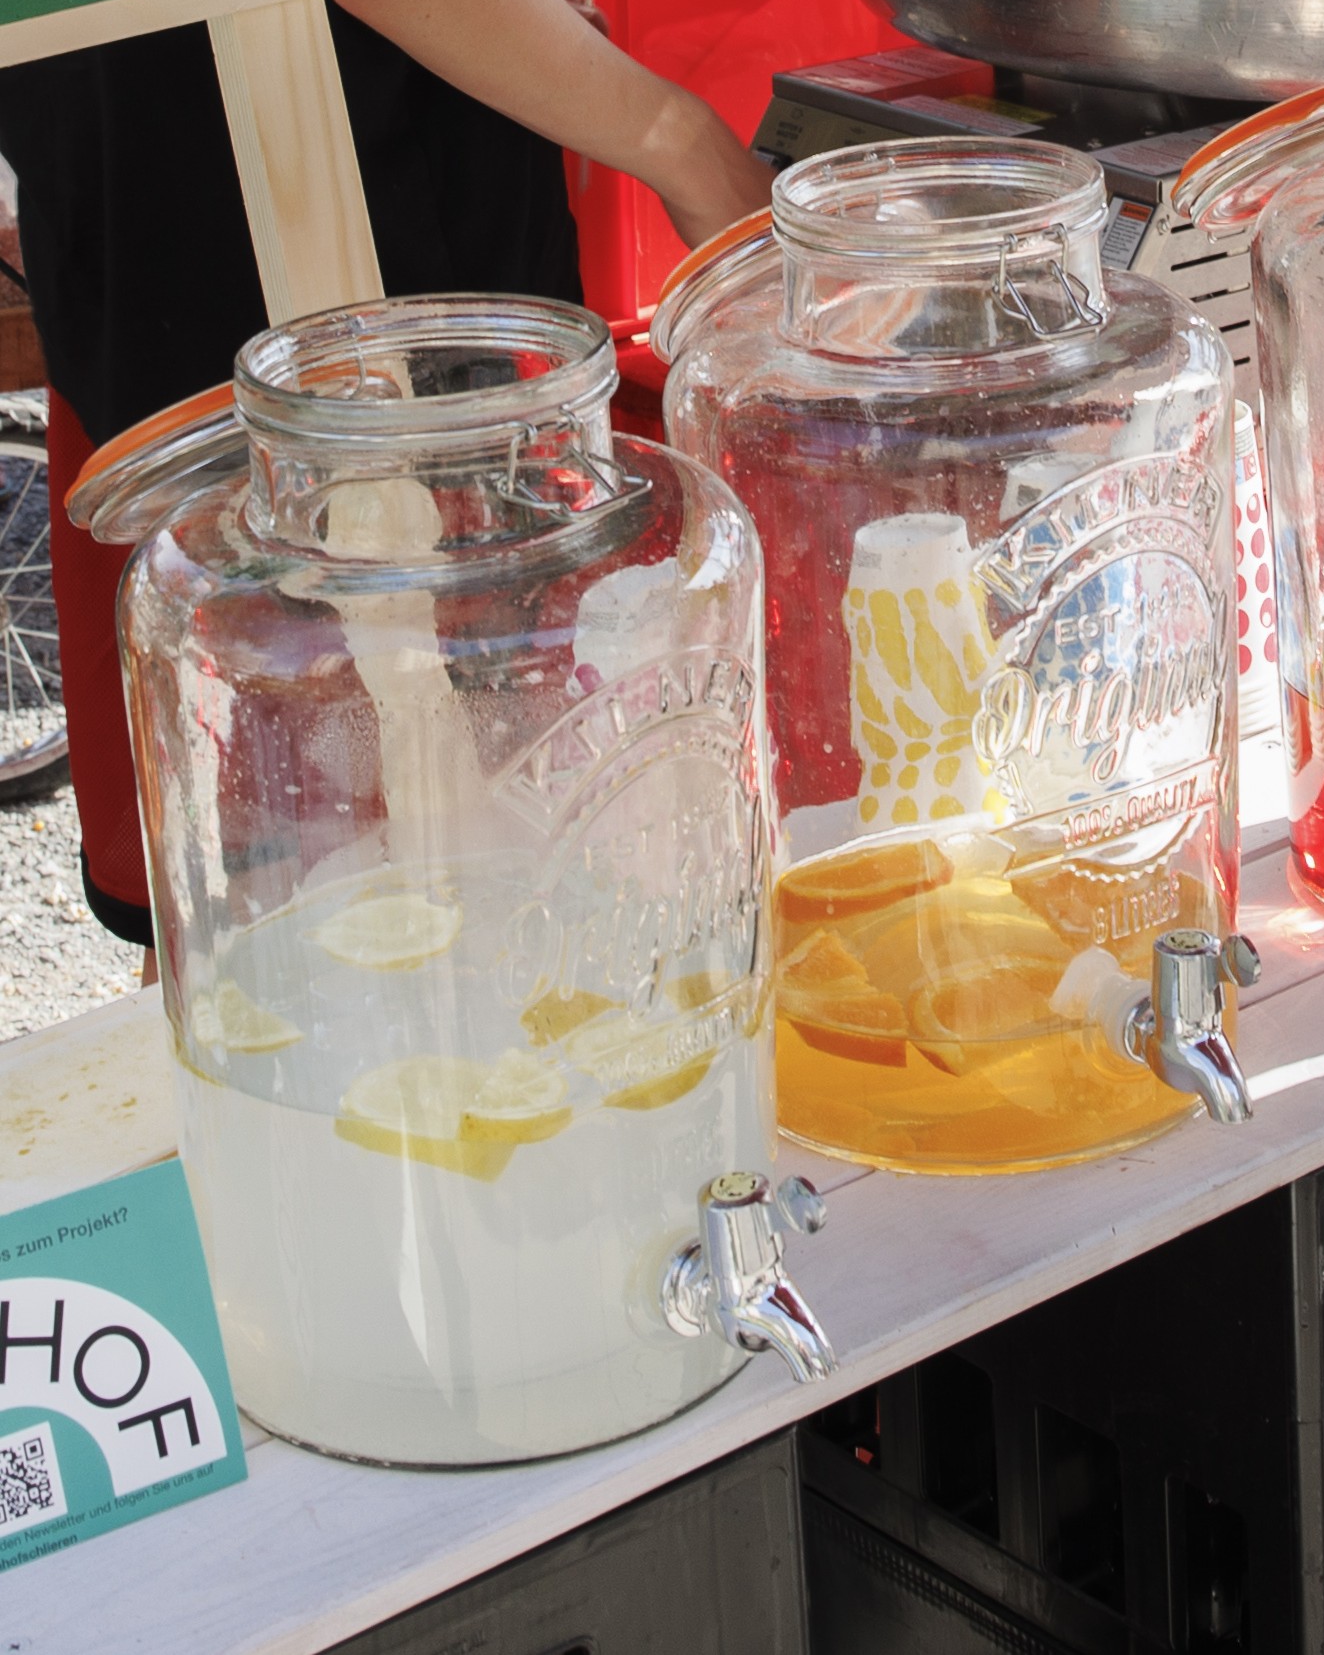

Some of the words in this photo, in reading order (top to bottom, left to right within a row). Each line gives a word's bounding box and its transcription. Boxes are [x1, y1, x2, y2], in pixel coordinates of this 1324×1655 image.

[990, 463, 1224, 606] KILNER
[1055, 602, 1122, 646] EST
[971, 594, 1228, 784] Original
[16, 1235, 54, 1258] zum
[57, 1206, 129, 1244] Projekt?
[24, 1511, 86, 1542] Newsletter
[89, 1500, 112, 1519] und
[114, 1487, 151, 1511] folgen
[152, 1479, 171, 1497] Sie
[173, 1473, 195, 1488] uns
[196, 1462, 215, 1480] auf
